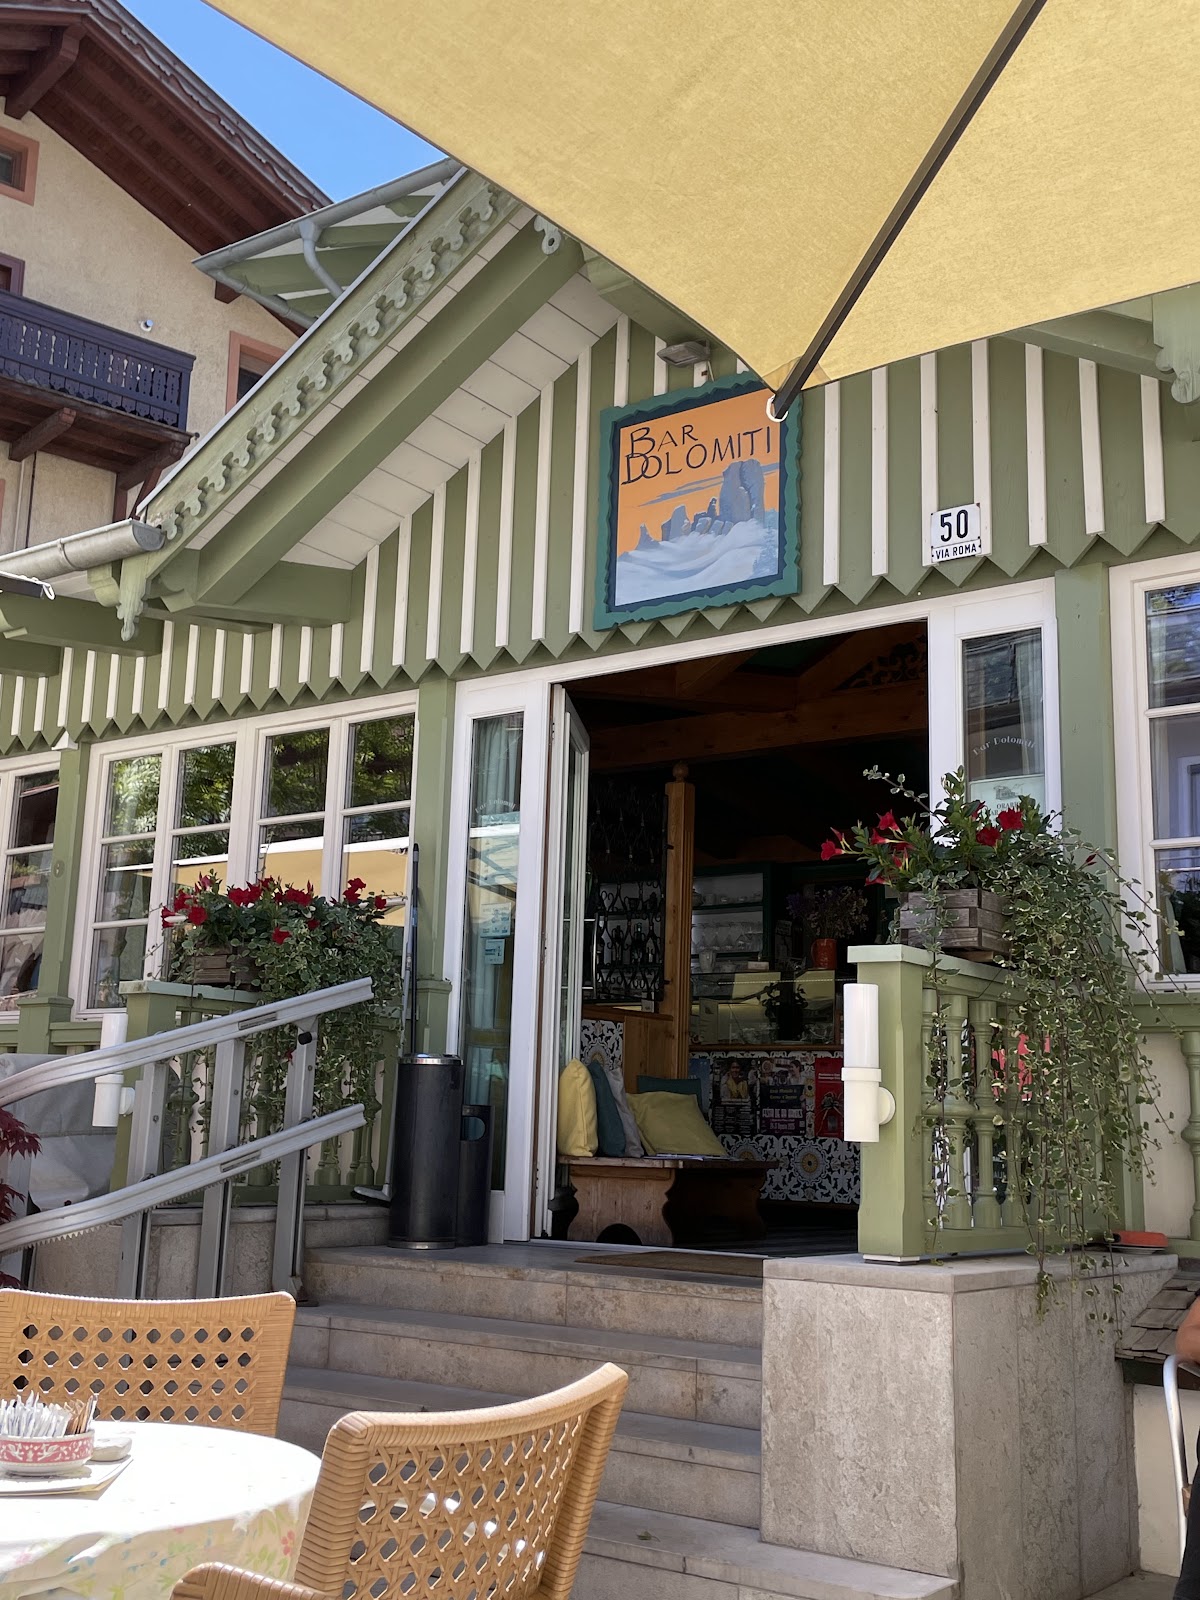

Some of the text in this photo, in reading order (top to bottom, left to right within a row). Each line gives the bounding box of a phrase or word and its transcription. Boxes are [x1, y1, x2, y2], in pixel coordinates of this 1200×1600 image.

[621, 425, 771, 485] DOLOMITI
[630, 424, 698, 458] BAR
[940, 509, 968, 542] 50
[935, 543, 976, 560] VIA ROMA
